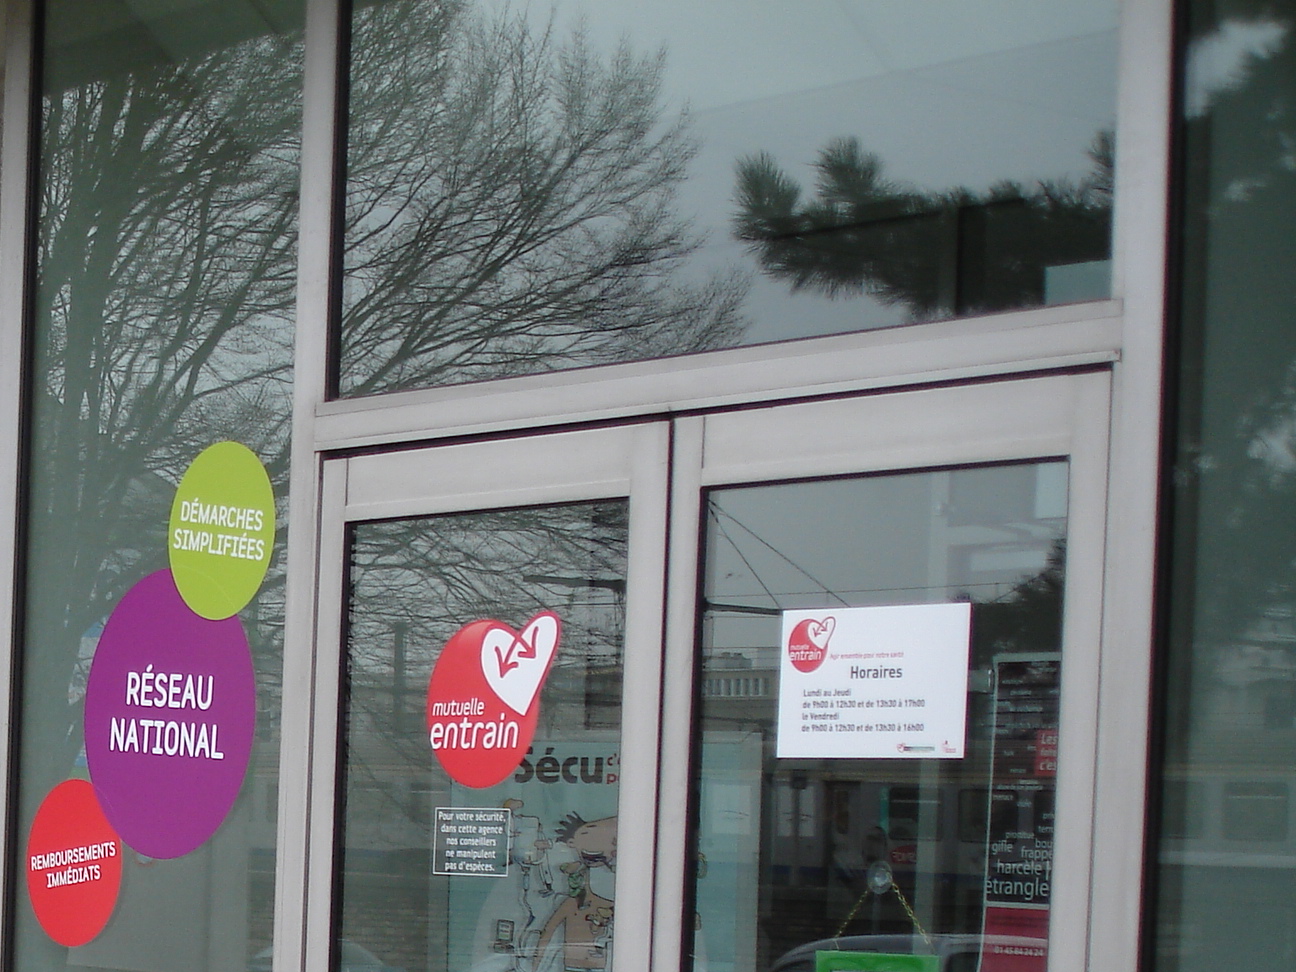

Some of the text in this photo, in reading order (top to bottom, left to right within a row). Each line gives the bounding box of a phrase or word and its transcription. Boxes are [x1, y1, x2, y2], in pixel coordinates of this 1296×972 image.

[180, 497, 263, 532] DÉMARCHES
[172, 528, 264, 561] SIMPLIFIÉES
[789, 648, 822, 661] entrain
[850, 665, 903, 679] Horaires
[126, 663, 214, 710] RÉSEAU
[803, 687, 852, 697] Lundi au Jeudi
[432, 697, 484, 716] mutuelle
[802, 698, 925, 709] de 9h00 à 12h30 et de 13h30 à 17h00
[801, 712, 840, 720] le Vendredi
[430, 712, 519, 749] entrain
[801, 722, 924, 732] de 9h00 à 12h30 et de 13h30 à 16h00
[109, 717, 224, 760] NATIONAL
[514, 746, 604, 784] Sécu
[438, 811, 454, 821] Pour
[456, 812, 474, 821] votre
[440, 823, 503, 835] dans cette agence
[446, 836, 497, 846] nos conseillers
[991, 840, 1014, 856] gifle
[30, 841, 116, 872] REMBOURSEMENTS
[445, 849, 496, 860] ne manipulent
[444, 862, 457, 872] pas
[997, 859, 1043, 875] harcèle
[46, 864, 101, 889] IMMÉDIATS
